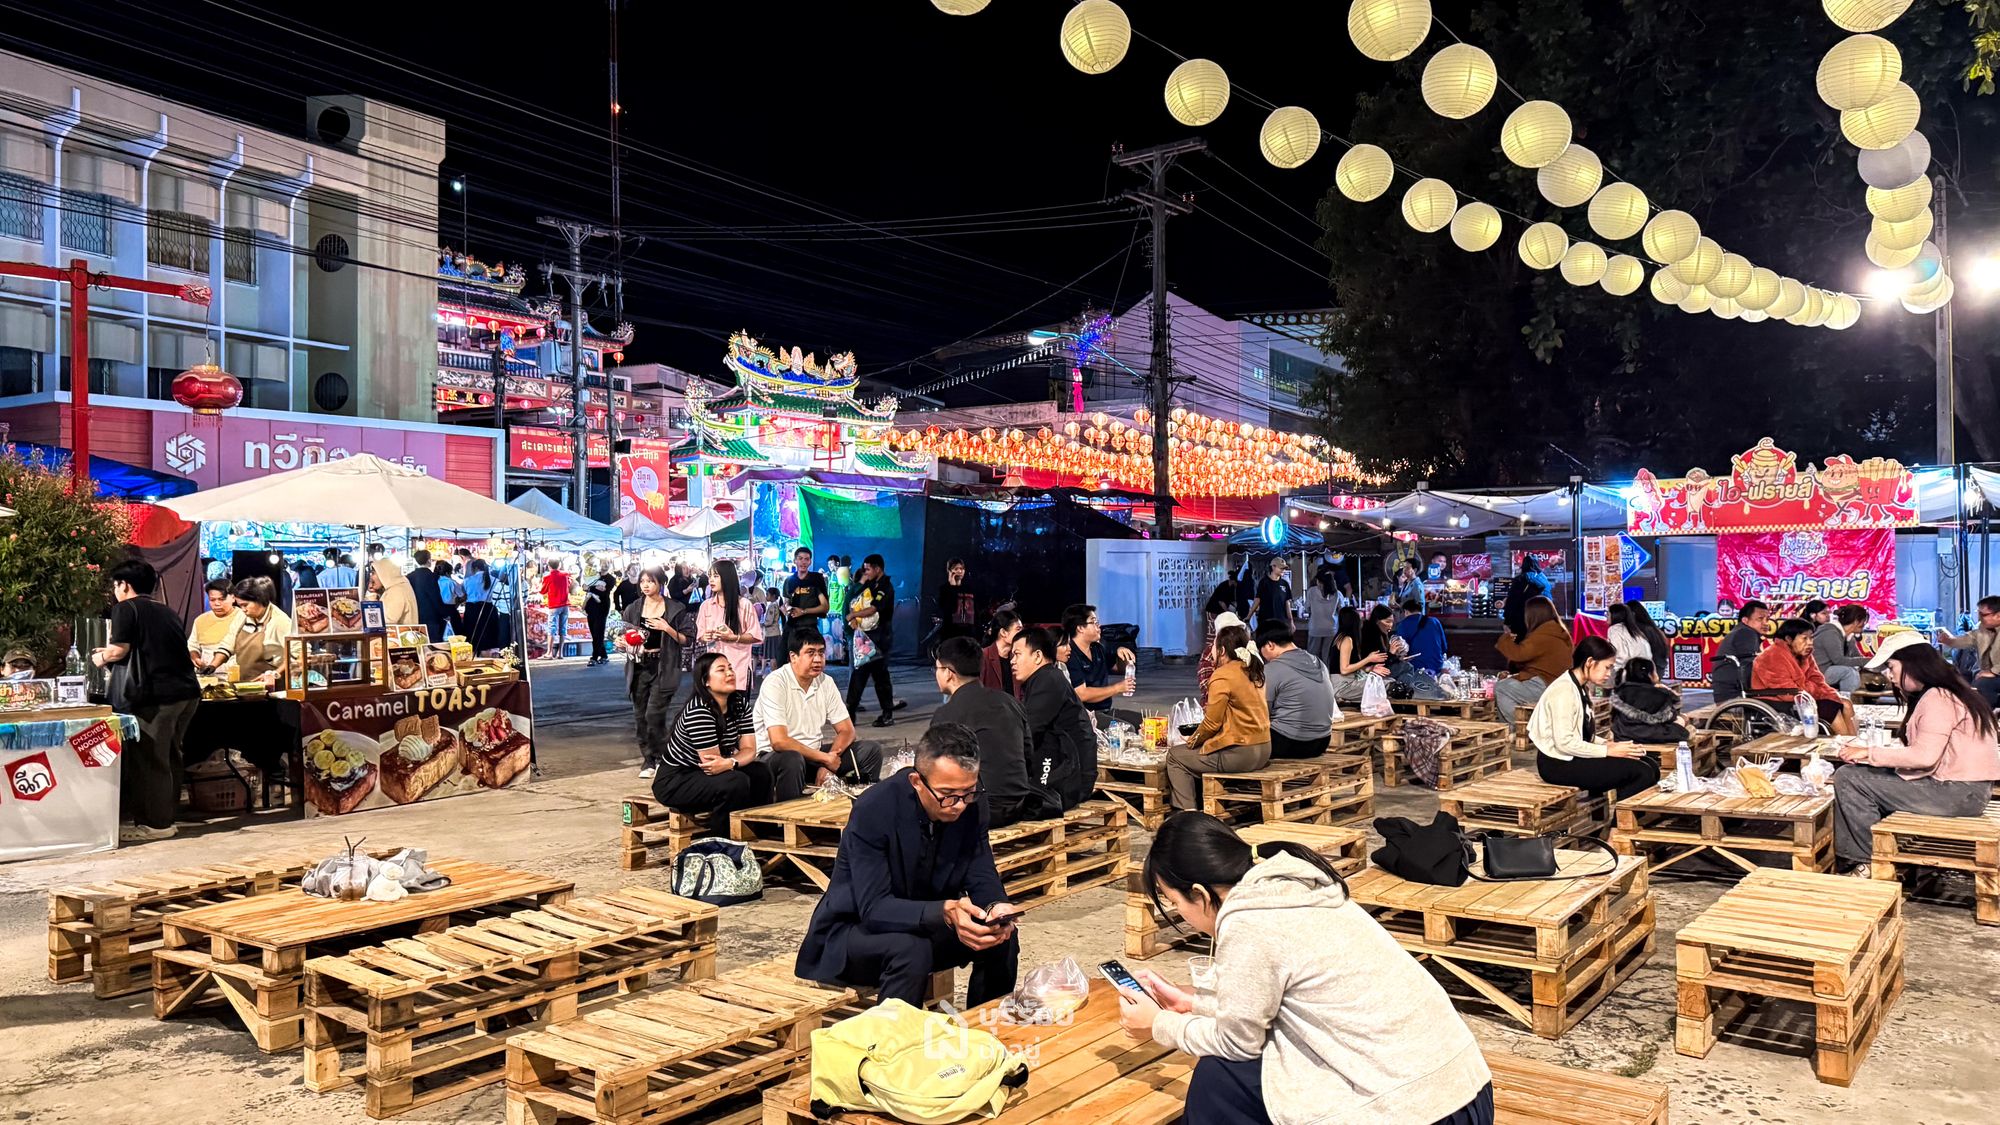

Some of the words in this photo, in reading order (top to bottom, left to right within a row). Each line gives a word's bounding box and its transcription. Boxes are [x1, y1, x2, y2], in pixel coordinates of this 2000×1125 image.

[1718, 478, 1815, 502] ไอ-ฟรายส์
[1740, 570, 1870, 600] ไอ-ฟรายส์
[326, 695, 409, 722] Caramel
[415, 684, 492, 713] TOAST
[72, 722, 107, 746] CHICKEN
[77, 731, 109, 752] NOODLE
[15, 770, 51, 794] ฉีก
